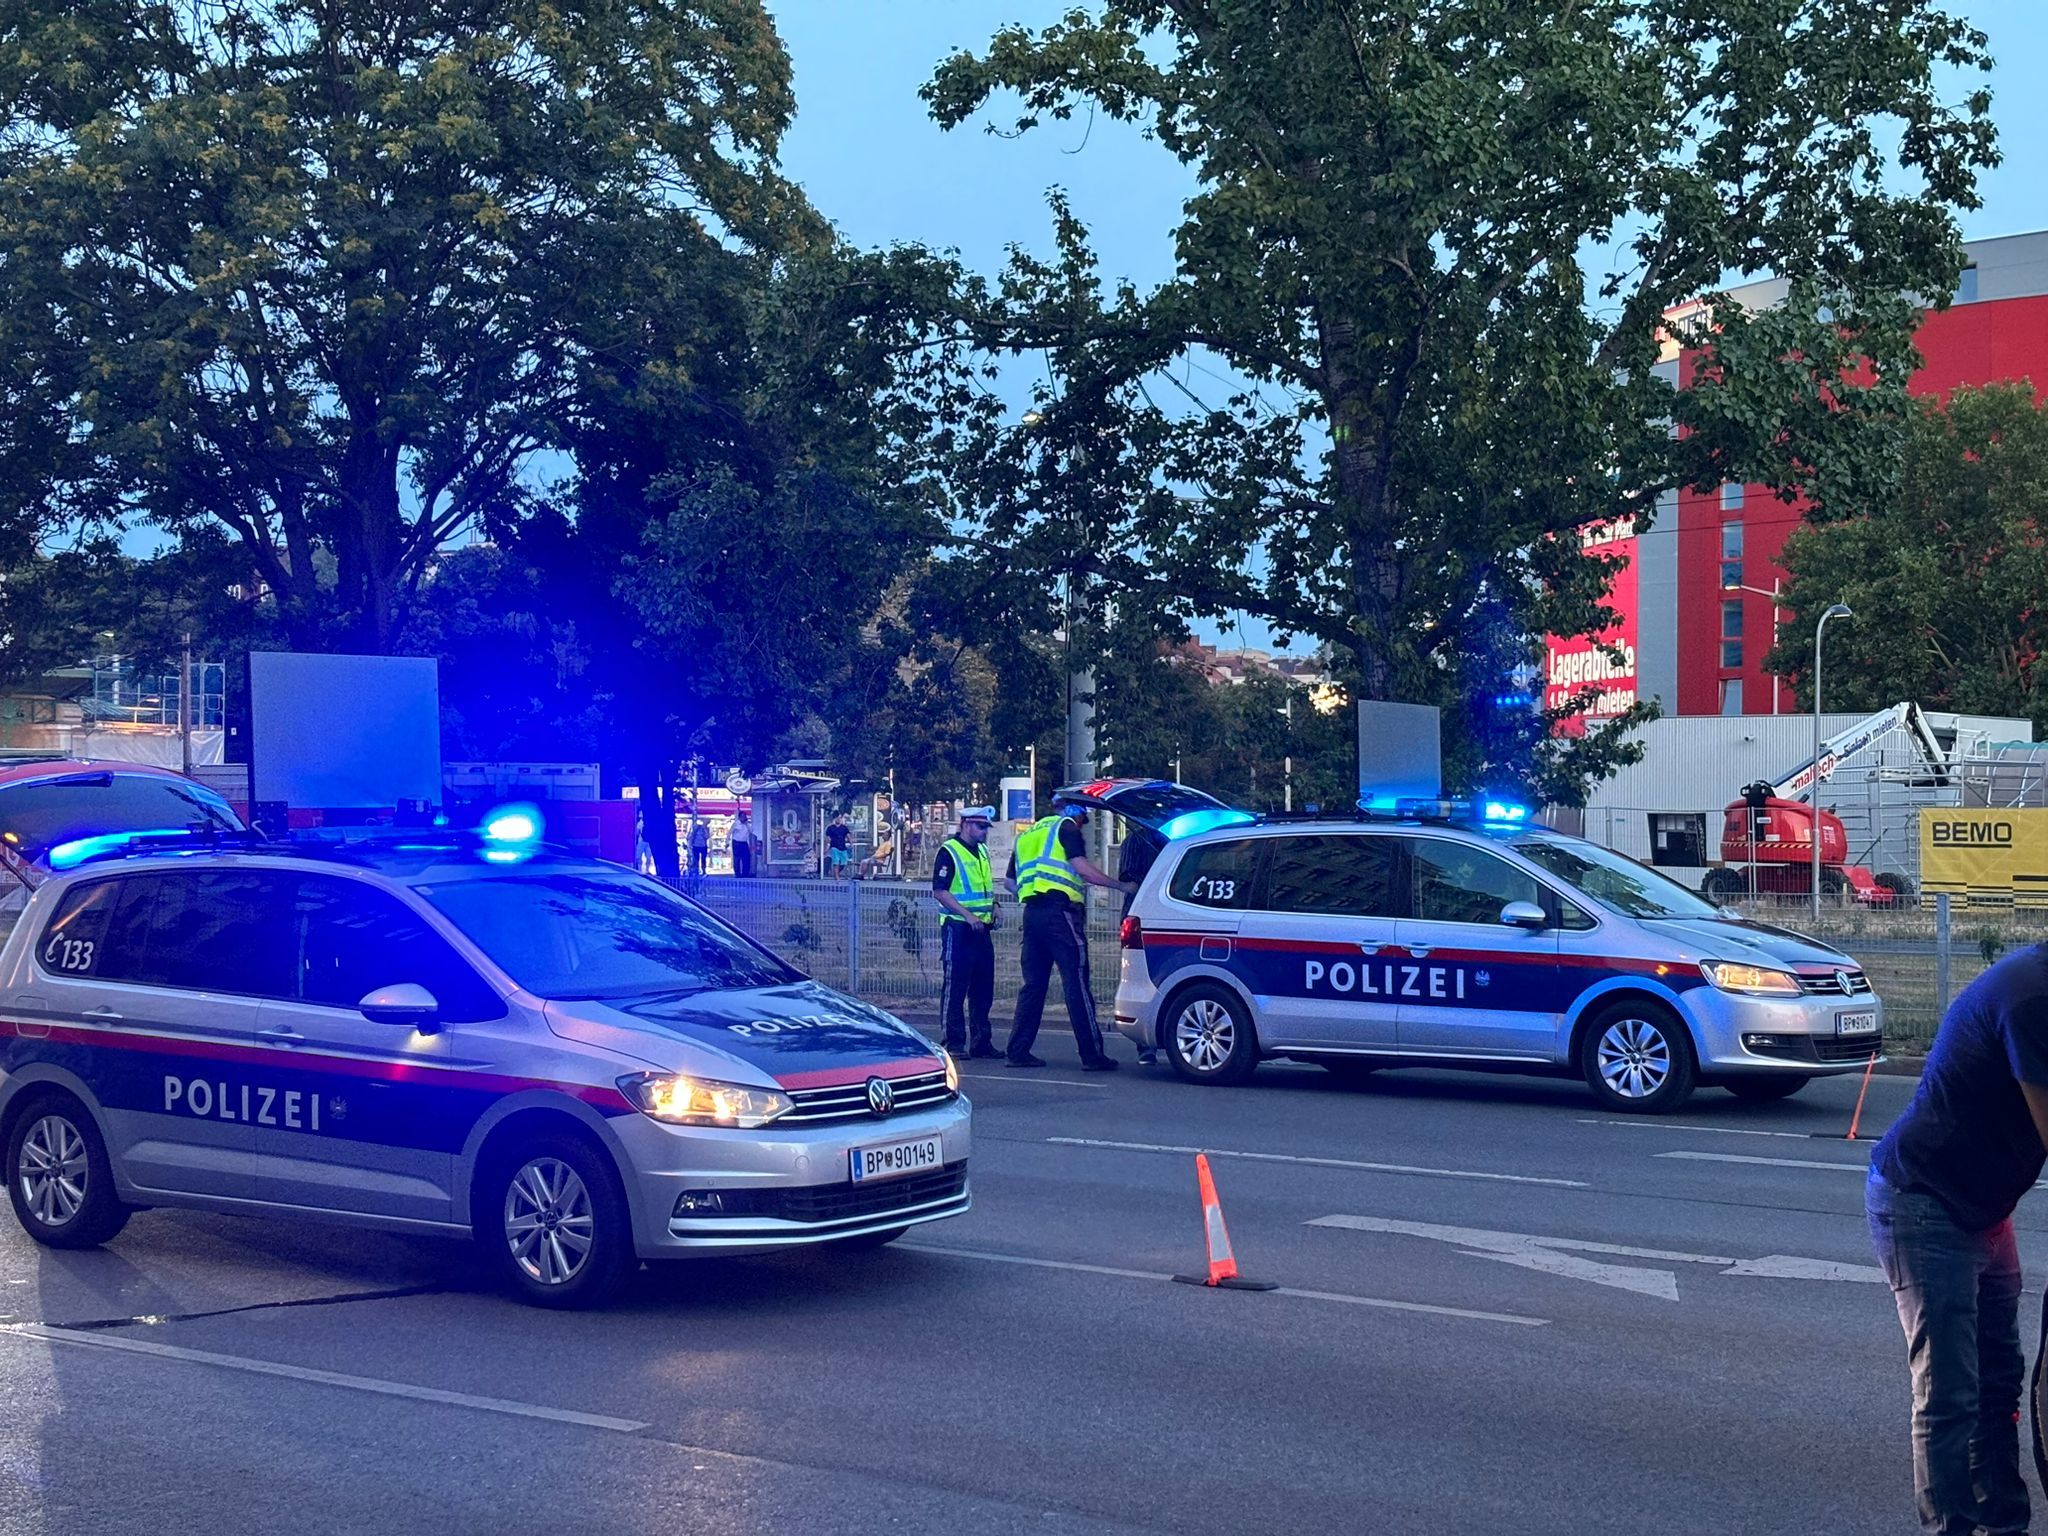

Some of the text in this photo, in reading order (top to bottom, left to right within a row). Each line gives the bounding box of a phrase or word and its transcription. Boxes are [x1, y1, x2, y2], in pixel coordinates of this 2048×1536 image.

[1597, 687, 1634, 714] mieten
[1872, 716, 1897, 740] mieten
[1932, 822, 2012, 842] BEMO
[1207, 880, 1235, 900] 133
[61, 940, 94, 970] 133
[1305, 960, 1465, 999] POLIZEI
[727, 1014, 862, 1037] POLIZEI
[164, 1075, 320, 1131] POLIZEI
[866, 1150, 884, 1173] BP
[895, 1142, 935, 1168] 90149
